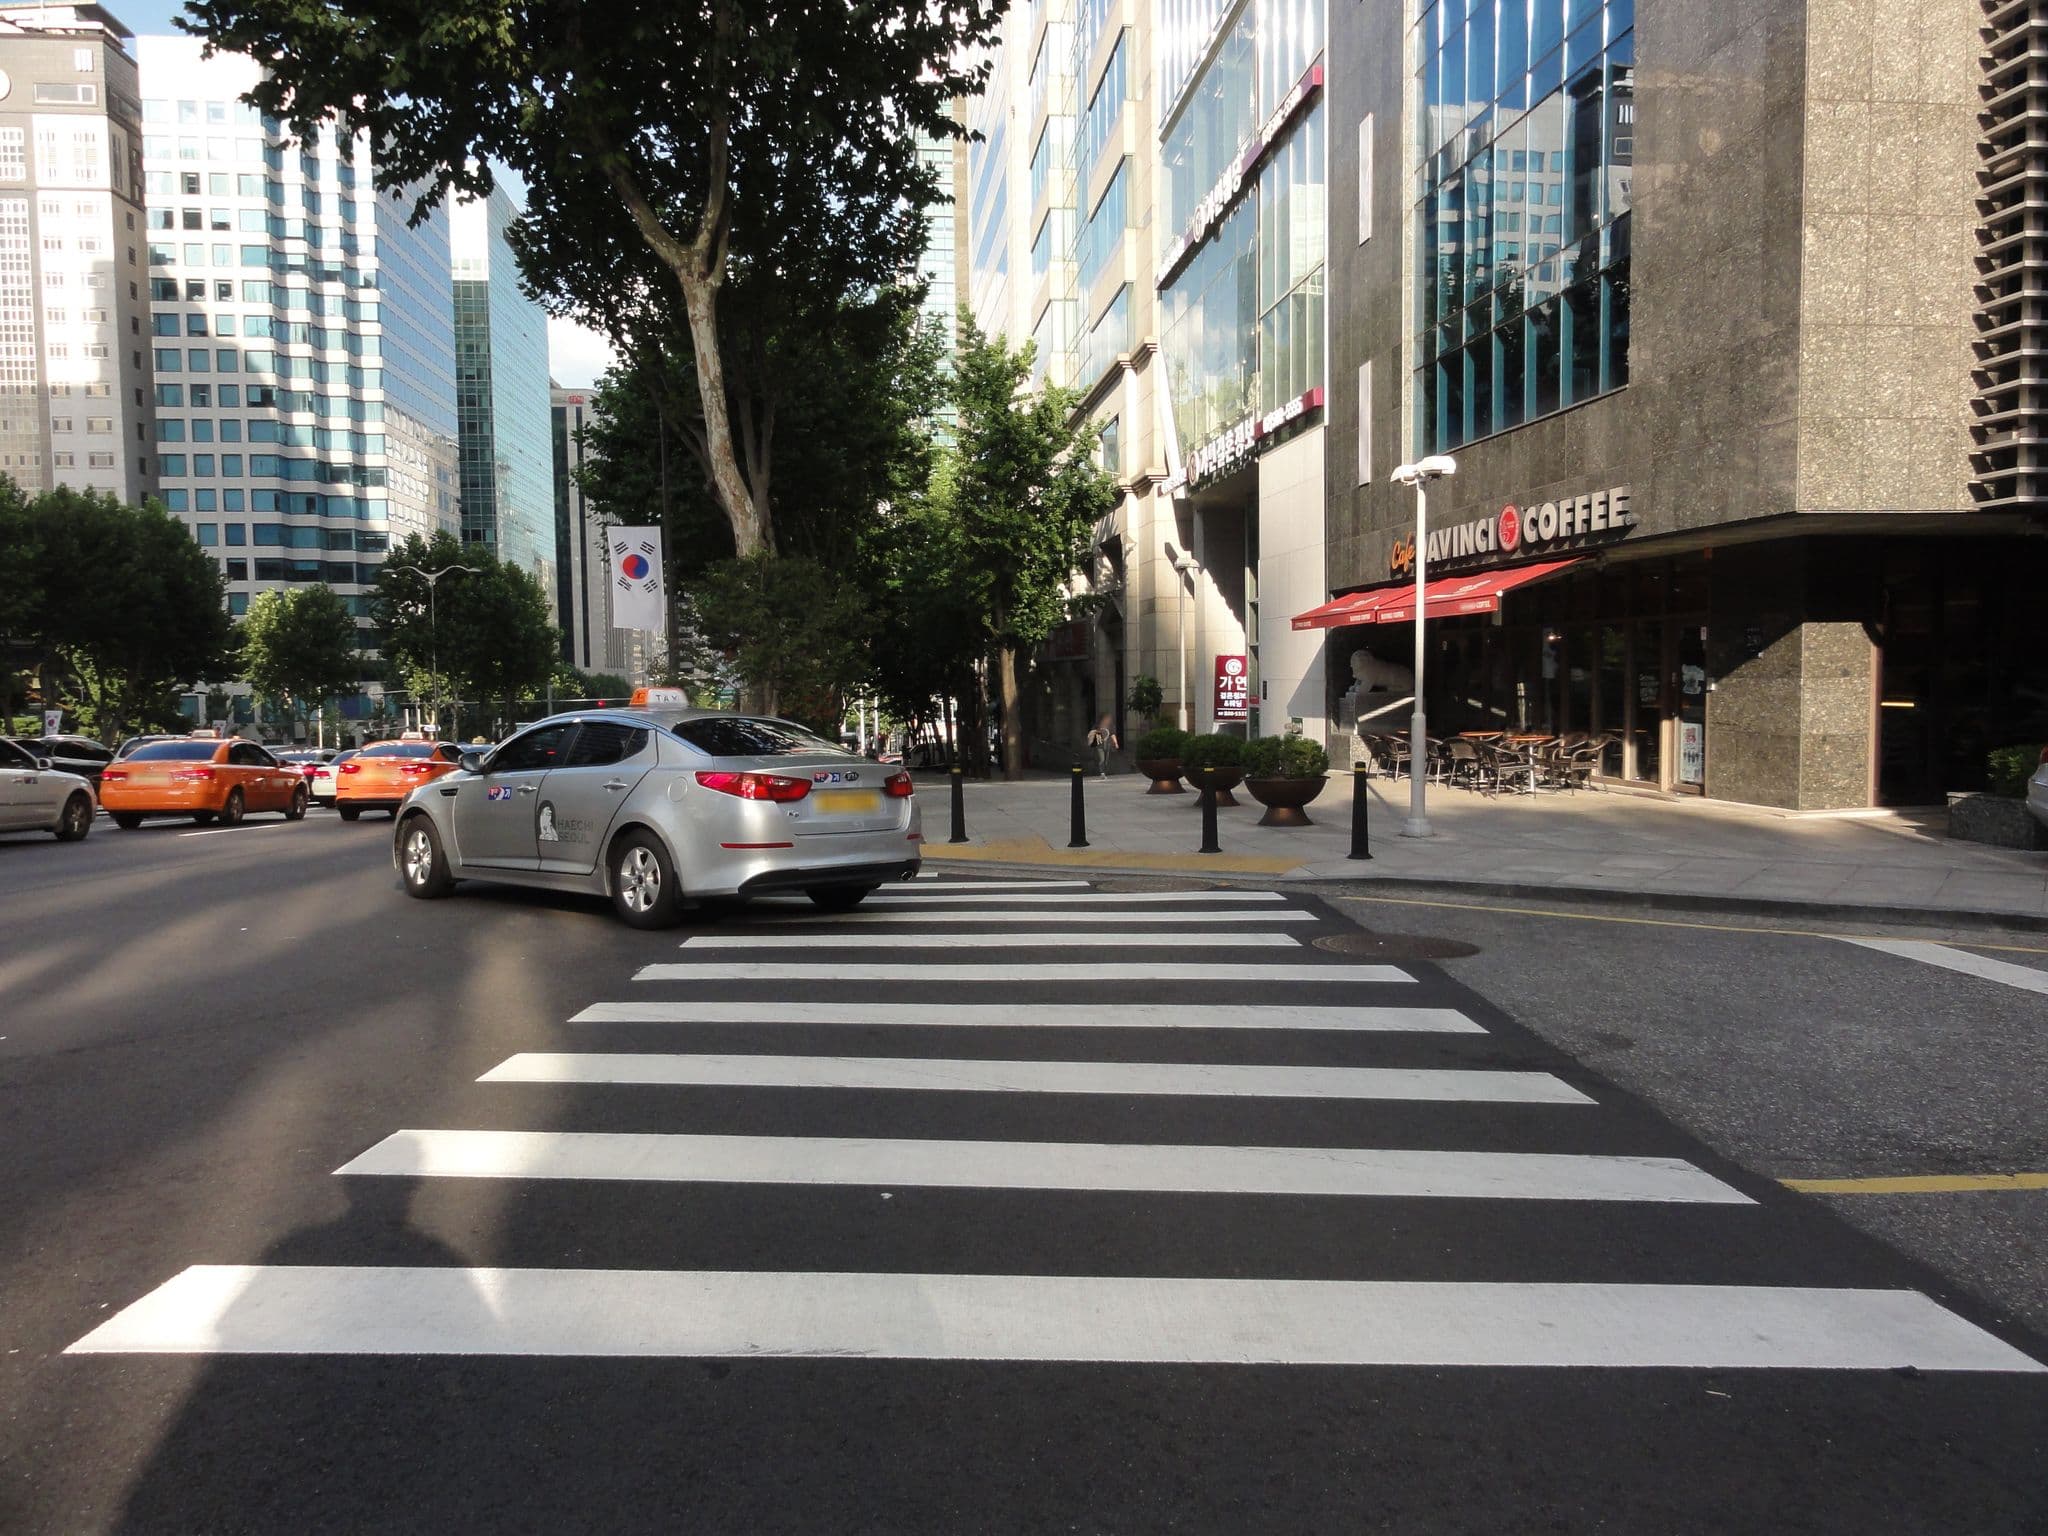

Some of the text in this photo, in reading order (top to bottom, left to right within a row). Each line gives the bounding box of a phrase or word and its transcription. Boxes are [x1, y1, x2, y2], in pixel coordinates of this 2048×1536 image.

[1391, 487, 1625, 571] Cafe AVINCI COFFEE
